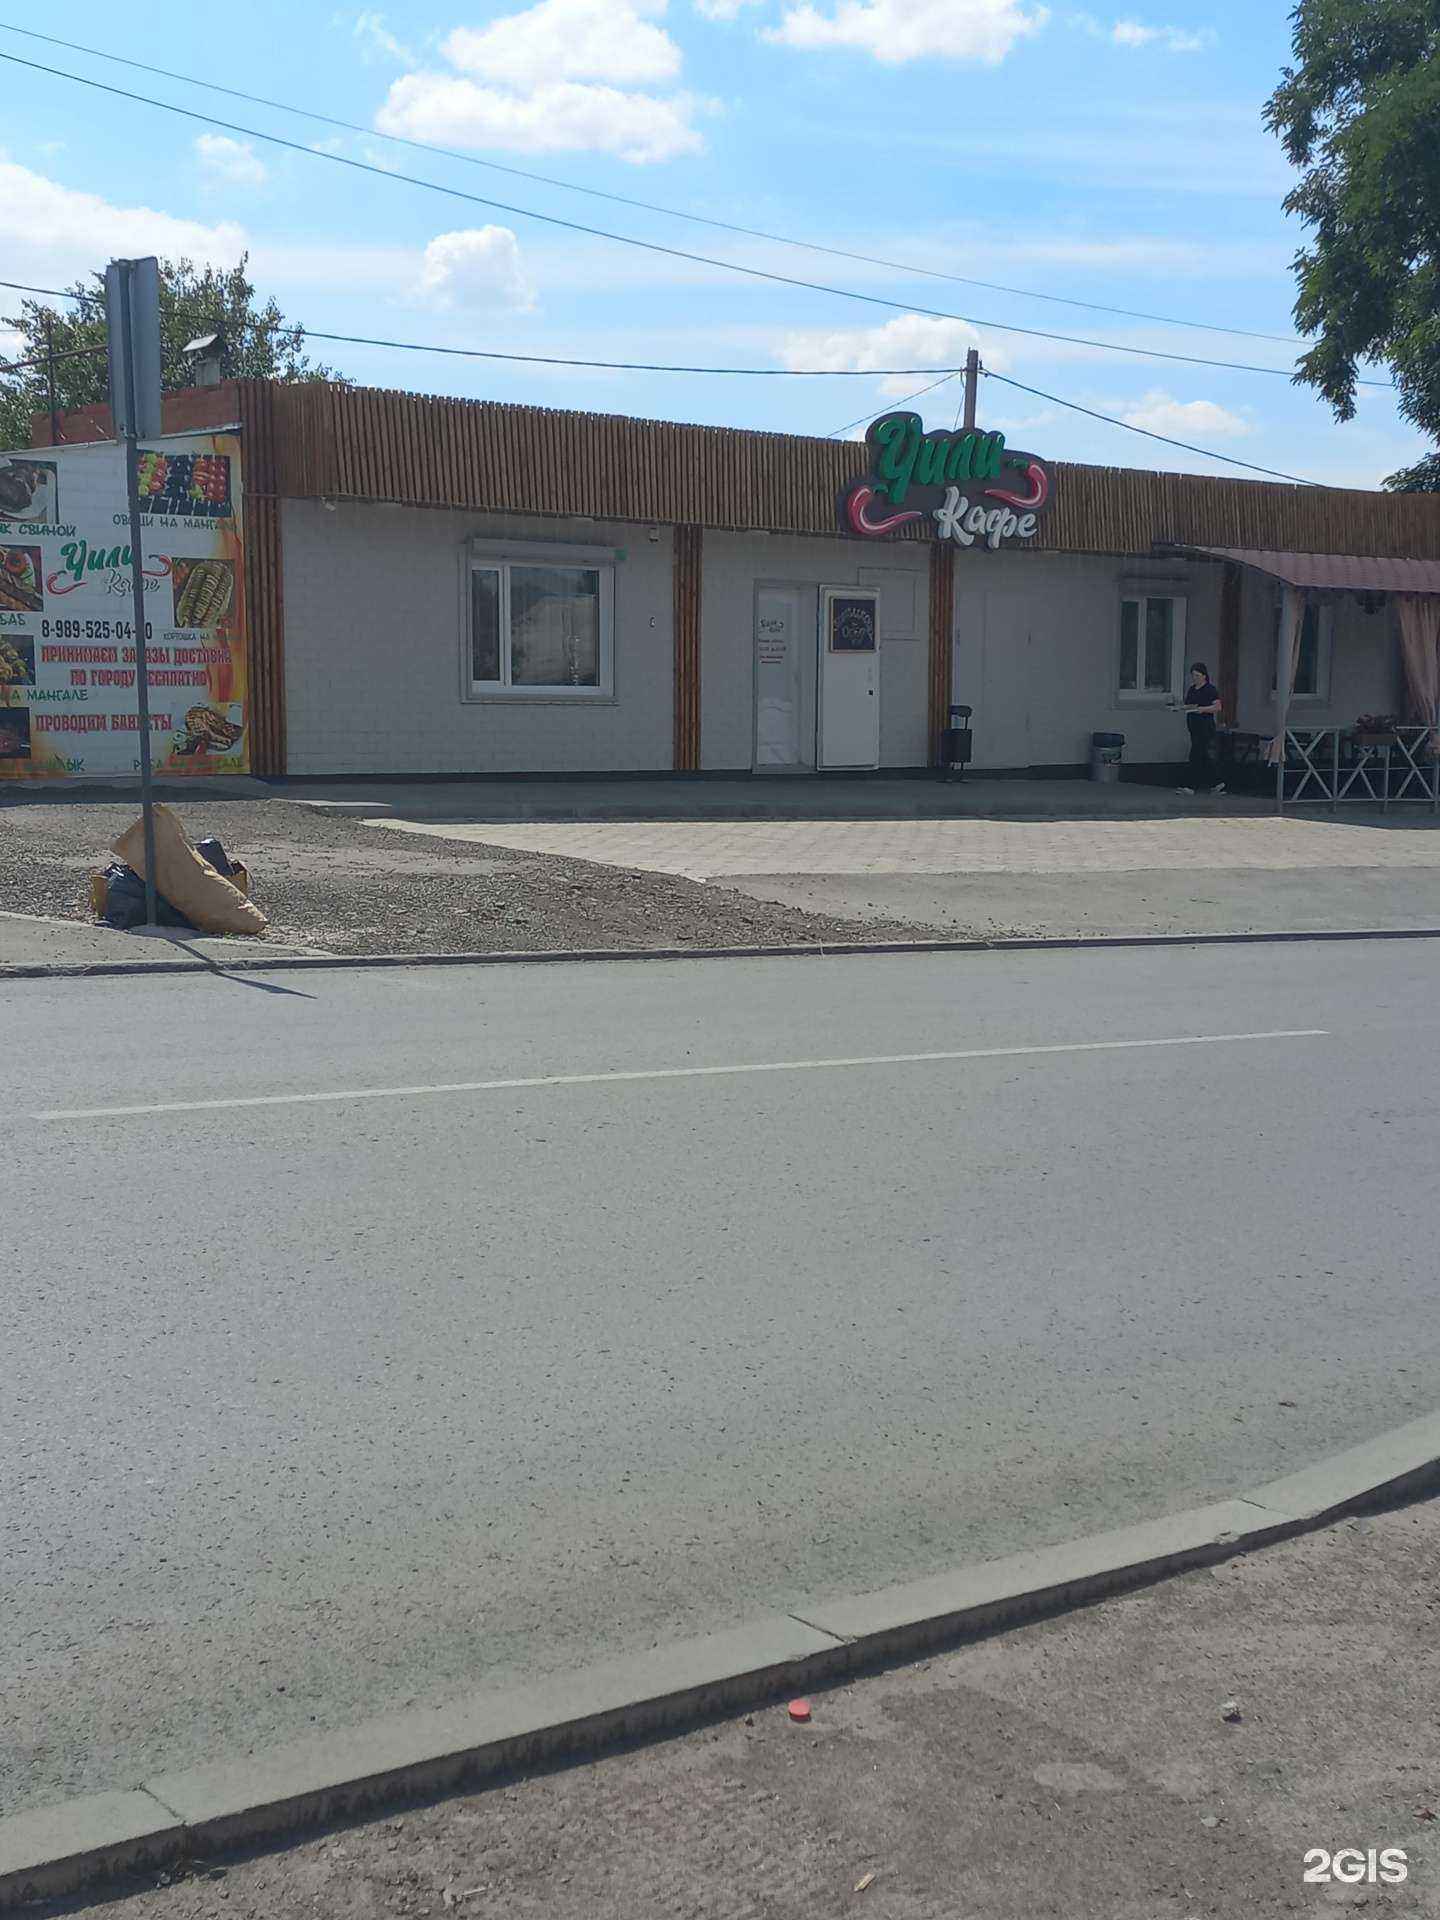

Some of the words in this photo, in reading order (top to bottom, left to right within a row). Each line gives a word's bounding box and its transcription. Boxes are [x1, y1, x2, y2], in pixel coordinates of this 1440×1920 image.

[876, 415, 1005, 504] Чили
[112, 514, 154, 527] ОВЩИ
[159, 516, 178, 528] НА
[933, 485, 1038, 549] Кафе
[18, 523, 76, 537] СВИНОЙ
[41, 619, 153, 640] 8-989-525-04-0
[41, 645, 118, 663] ПРИНИМАЕМ
[121, 646, 170, 664] ЗААЗЫ
[174, 648, 232, 665] ДОСТАВКА
[70, 669, 86, 686] ПО
[91, 669, 136, 688] ГОРОДУ
[145, 670, 207, 687] ЕСПЛАТНО
[27, 689, 89, 702] МАНГАЛЕ
[35, 714, 107, 733] ПРОВОДИМ
[111, 714, 172, 731] БАНТЫ
